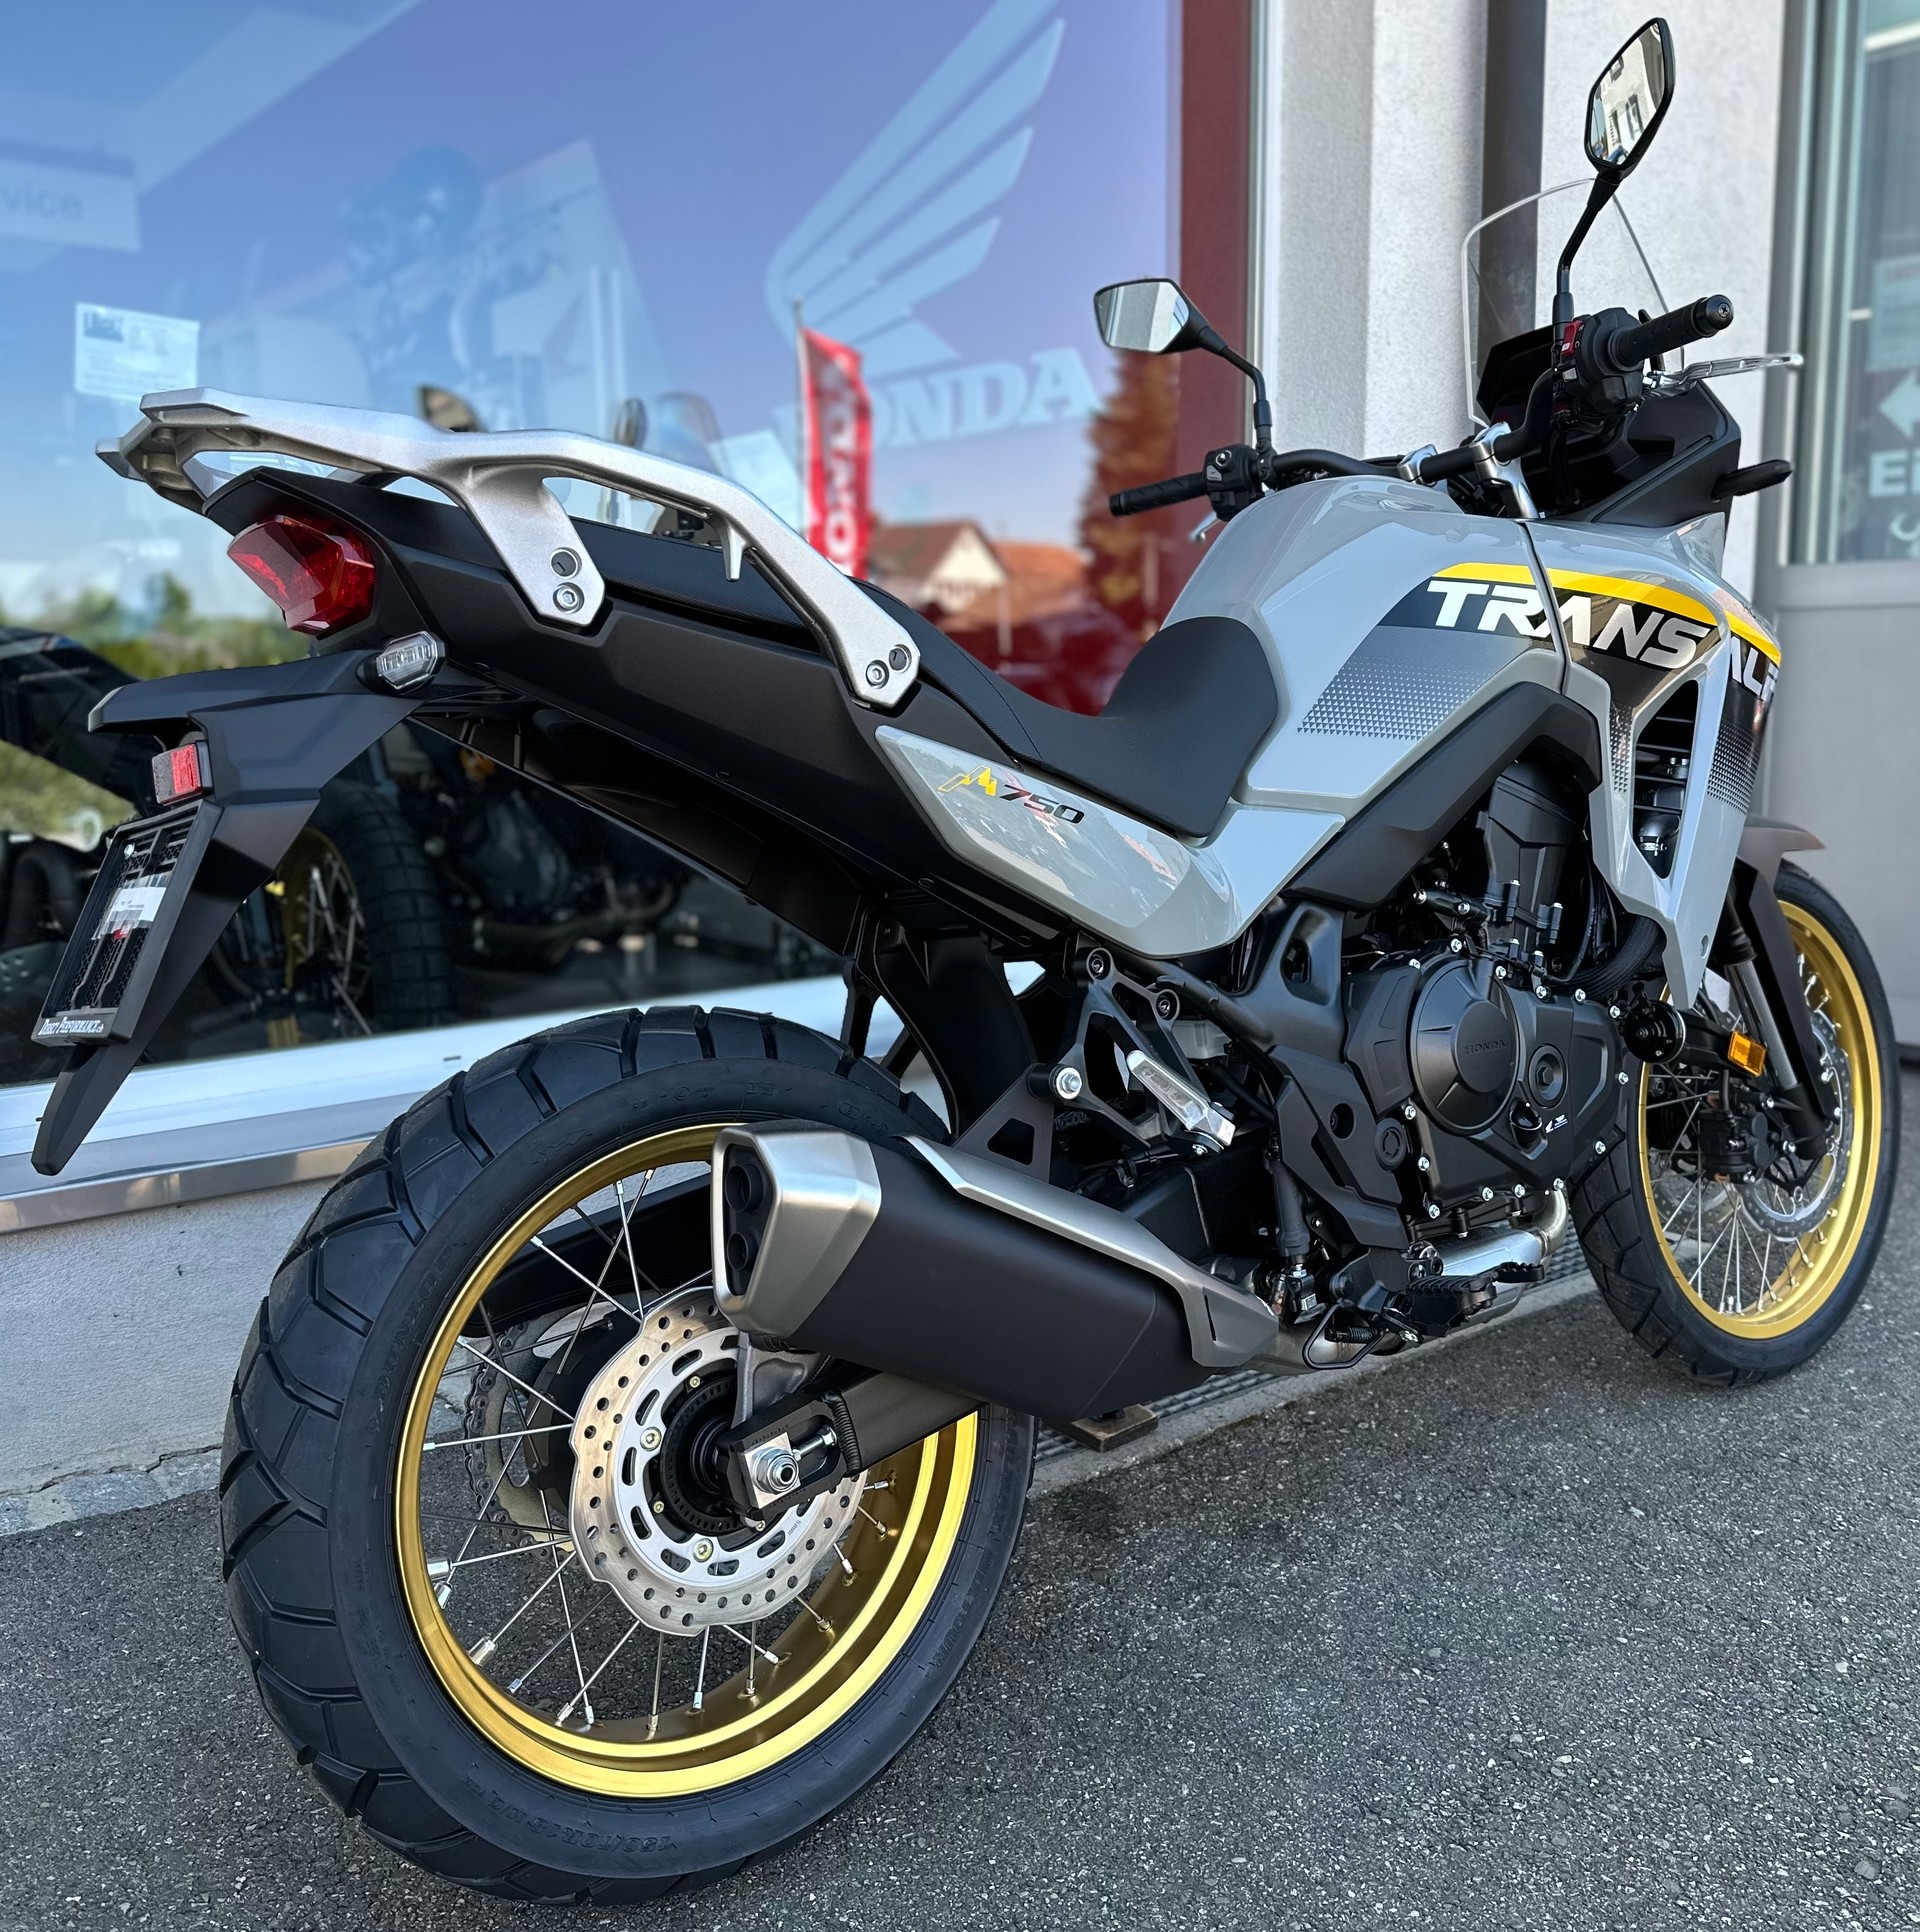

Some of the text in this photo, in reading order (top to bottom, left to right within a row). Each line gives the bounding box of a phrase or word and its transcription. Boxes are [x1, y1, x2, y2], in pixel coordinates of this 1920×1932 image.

[1000, 784, 1085, 824] 750
[1463, 1039, 1507, 1055] HONDA
[373, 1246, 452, 1400] DUNLOP
